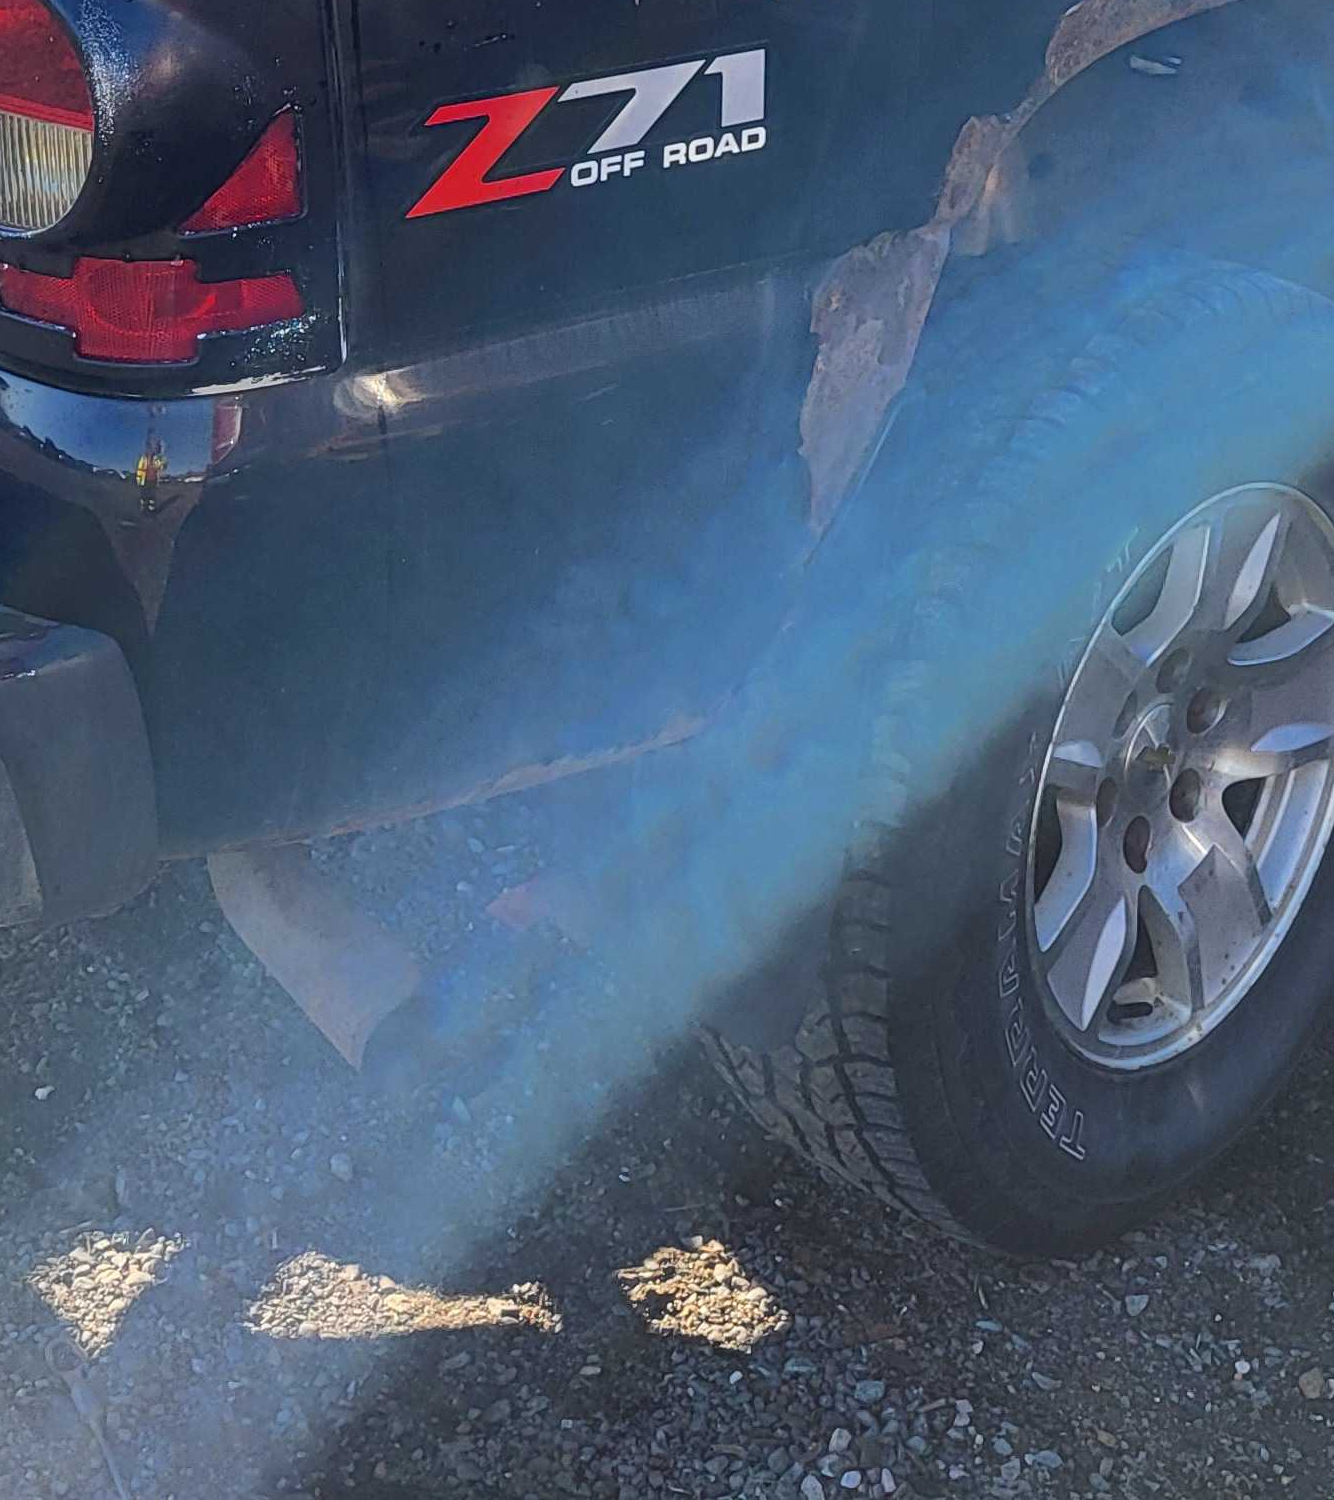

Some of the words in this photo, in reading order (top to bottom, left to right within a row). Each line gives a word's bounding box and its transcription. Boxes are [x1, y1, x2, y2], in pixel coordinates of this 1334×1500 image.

[404, 48, 767, 220] Z71
[570, 150, 646, 188] OFF
[662, 126, 767, 169] ROAD
